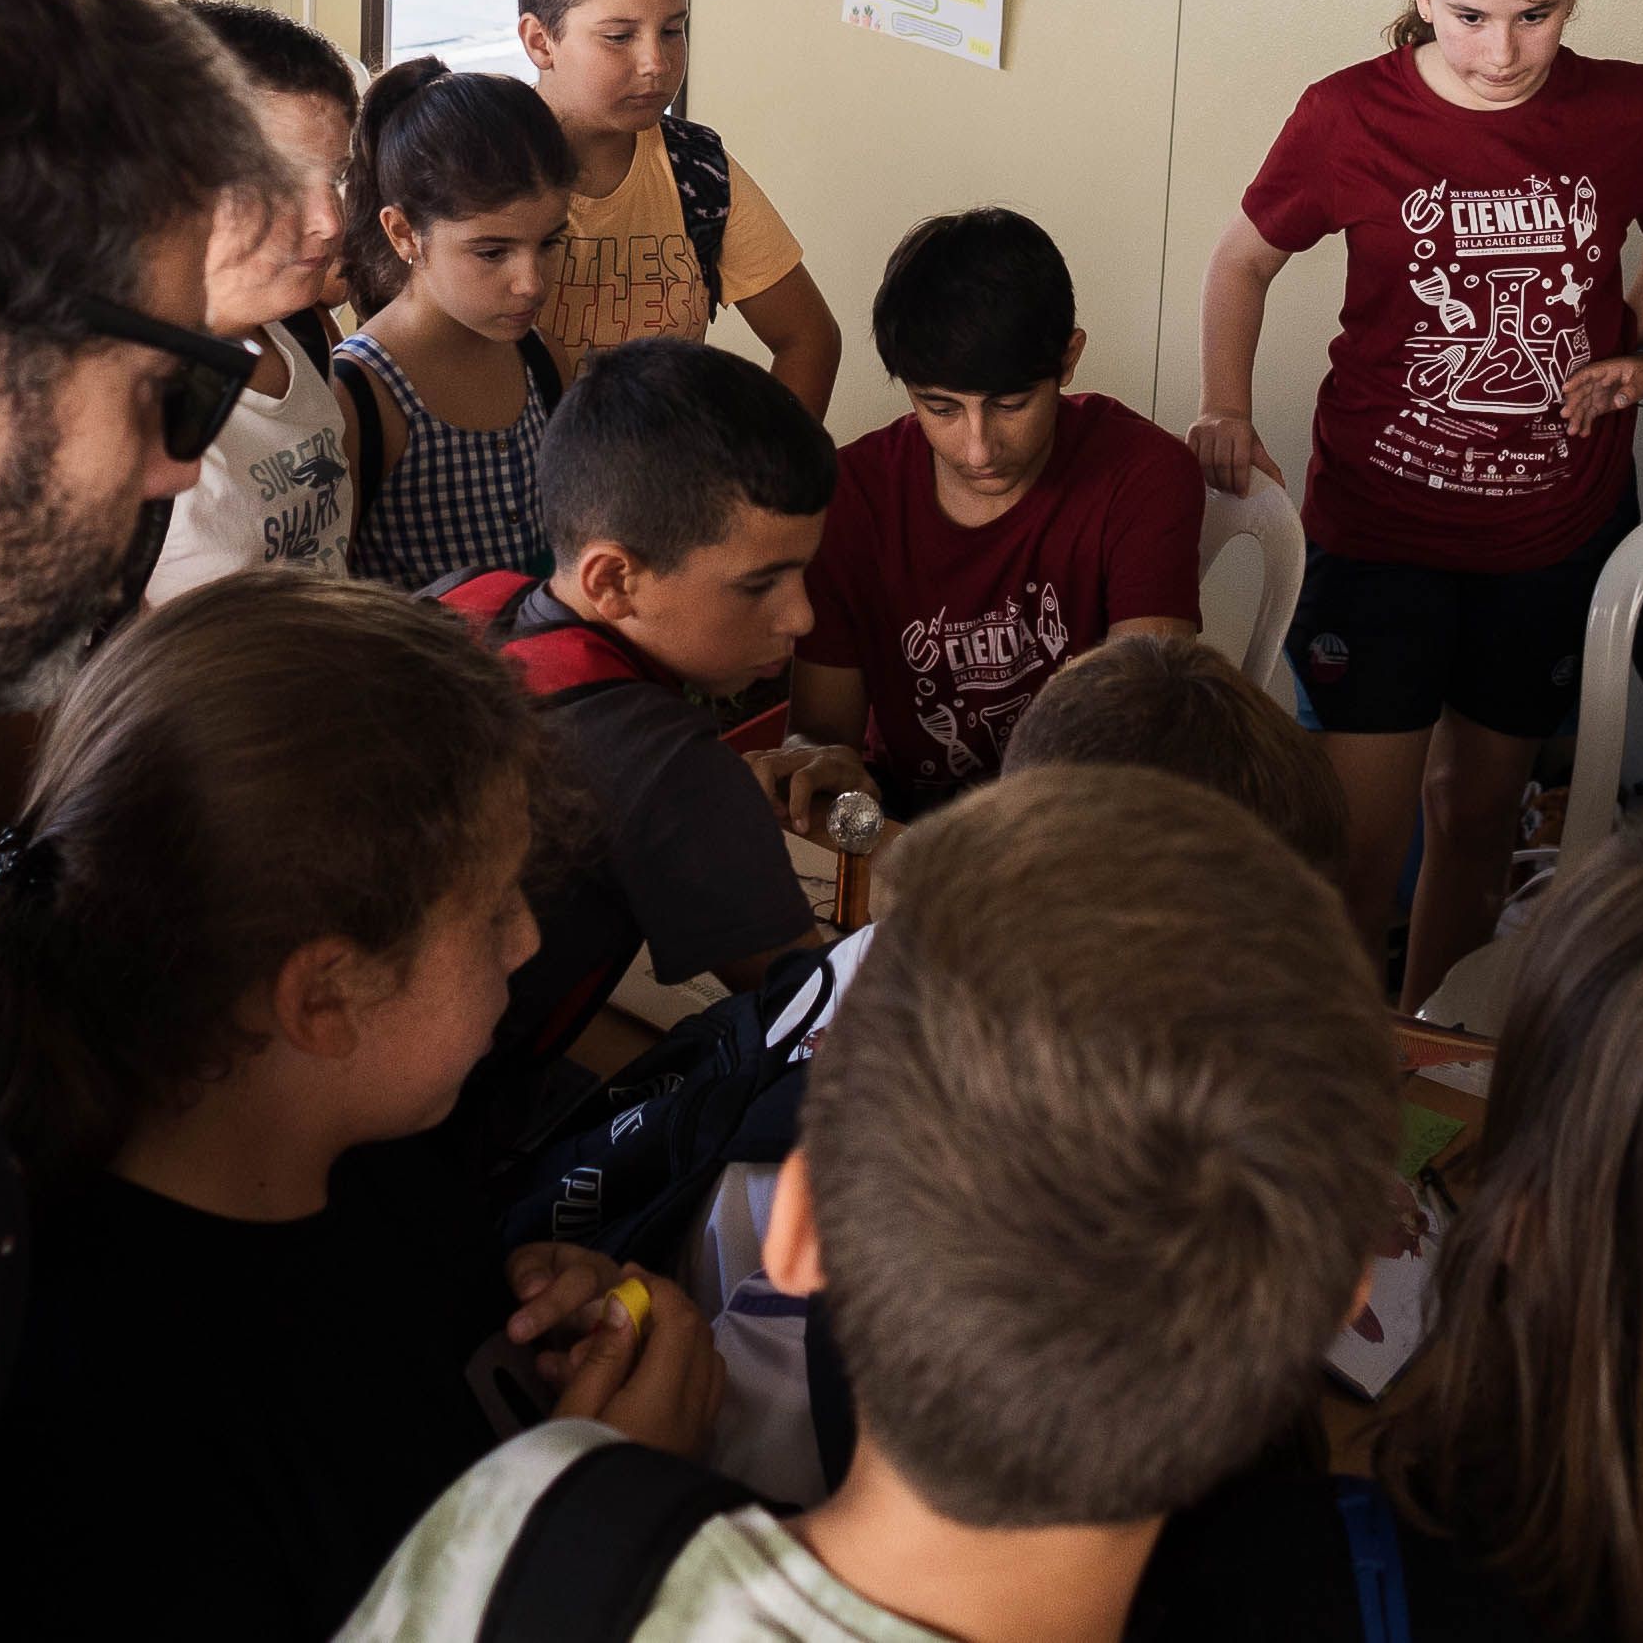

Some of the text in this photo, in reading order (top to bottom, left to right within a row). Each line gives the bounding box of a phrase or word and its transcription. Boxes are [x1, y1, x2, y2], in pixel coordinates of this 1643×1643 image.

[1450, 188, 1522, 198] XI FERIA DE LA
[1451, 197, 1566, 235] CIENCIA
[1455, 234, 1563, 249] EN LA CALLE DE JEREZ
[1509, 452, 1545, 461] HOLCIM
